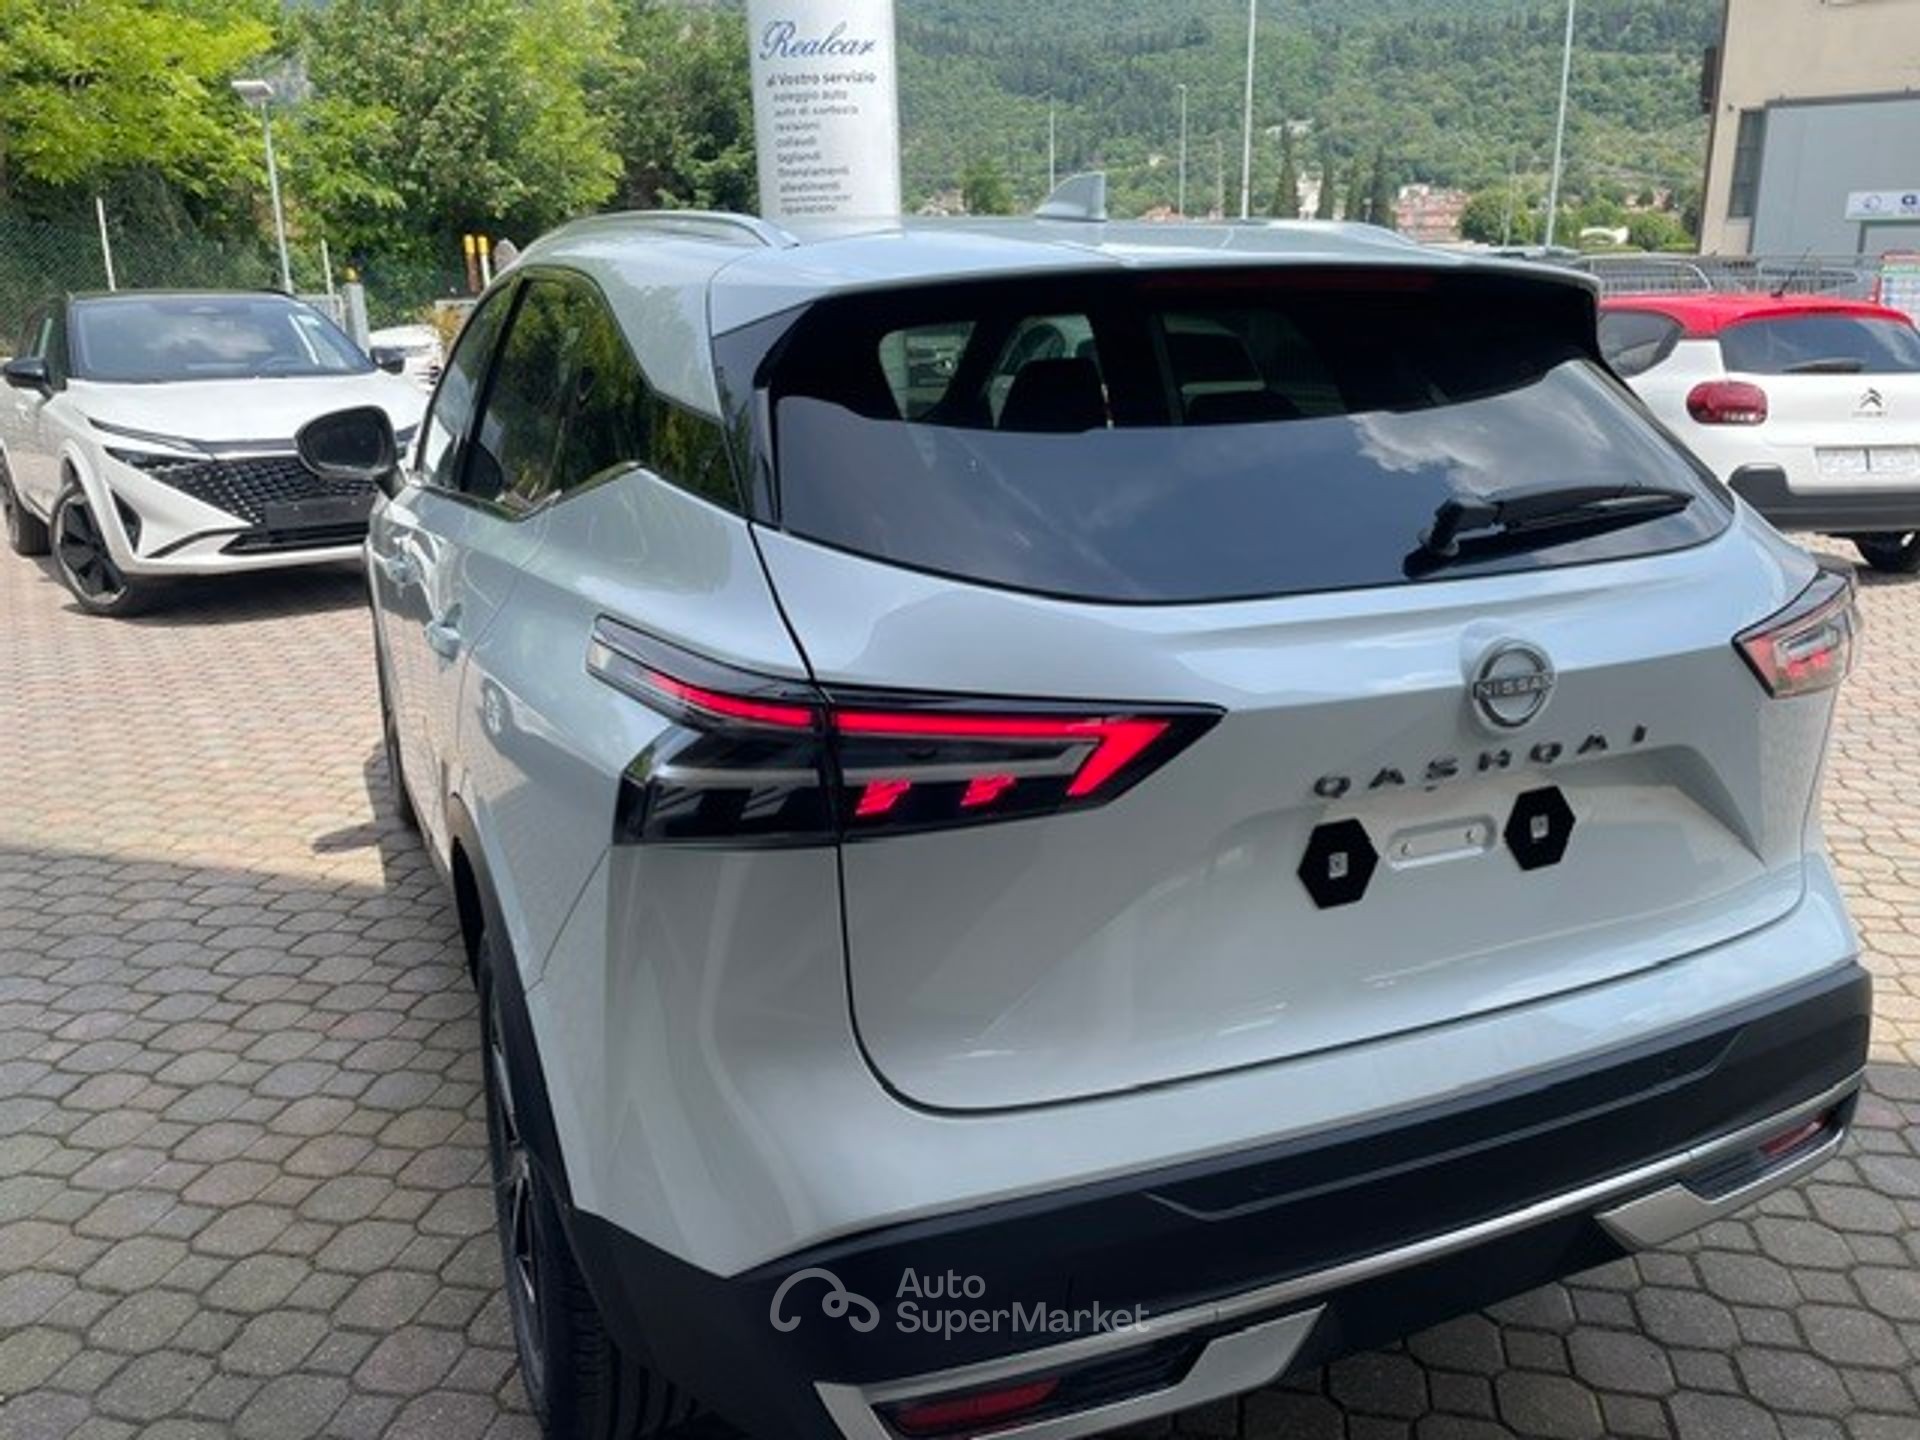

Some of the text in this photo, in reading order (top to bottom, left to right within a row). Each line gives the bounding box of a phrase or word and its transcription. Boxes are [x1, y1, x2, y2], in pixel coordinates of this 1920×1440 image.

[759, 20, 876, 60] Realcar
[777, 72, 820, 86] Vostro
[822, 70, 877, 84] servizio
[1313, 724, 1647, 799] QASHQAI
